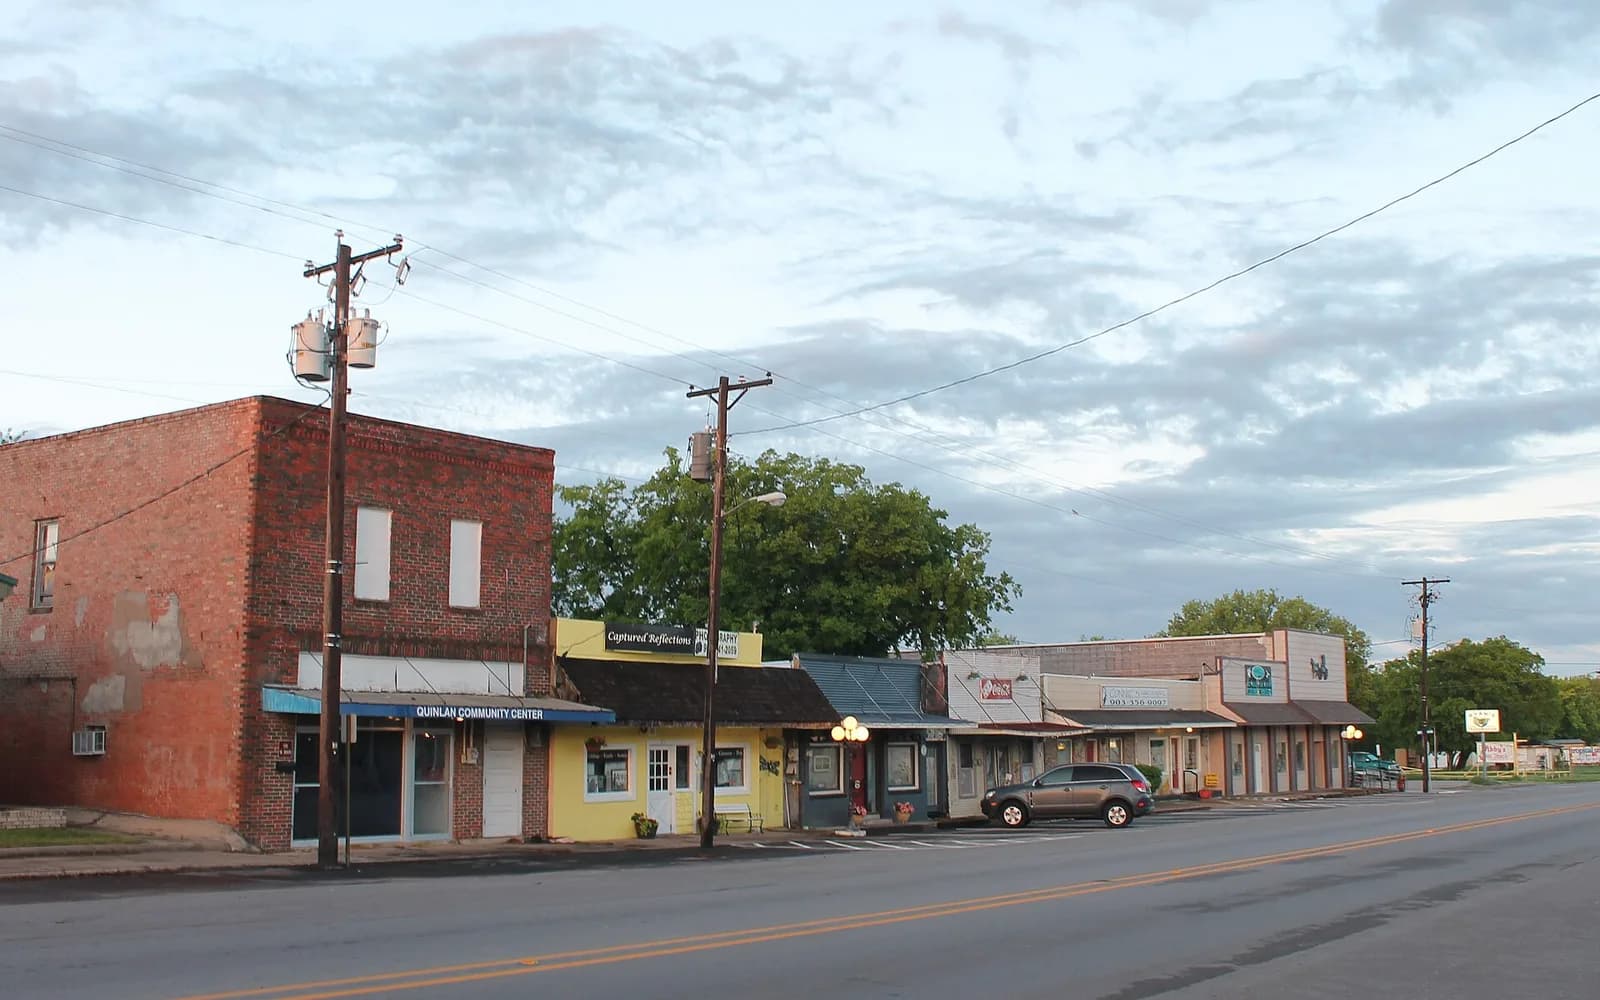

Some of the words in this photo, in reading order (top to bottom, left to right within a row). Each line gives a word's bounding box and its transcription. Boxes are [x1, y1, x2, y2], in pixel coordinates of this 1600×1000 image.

[607, 631, 649, 644] Captured
[649, 632, 692, 647] Reflections
[416, 706, 457, 718] QUINLAN
[458, 707, 510, 719] COMMUNITY
[511, 709, 543, 720] CENTER
